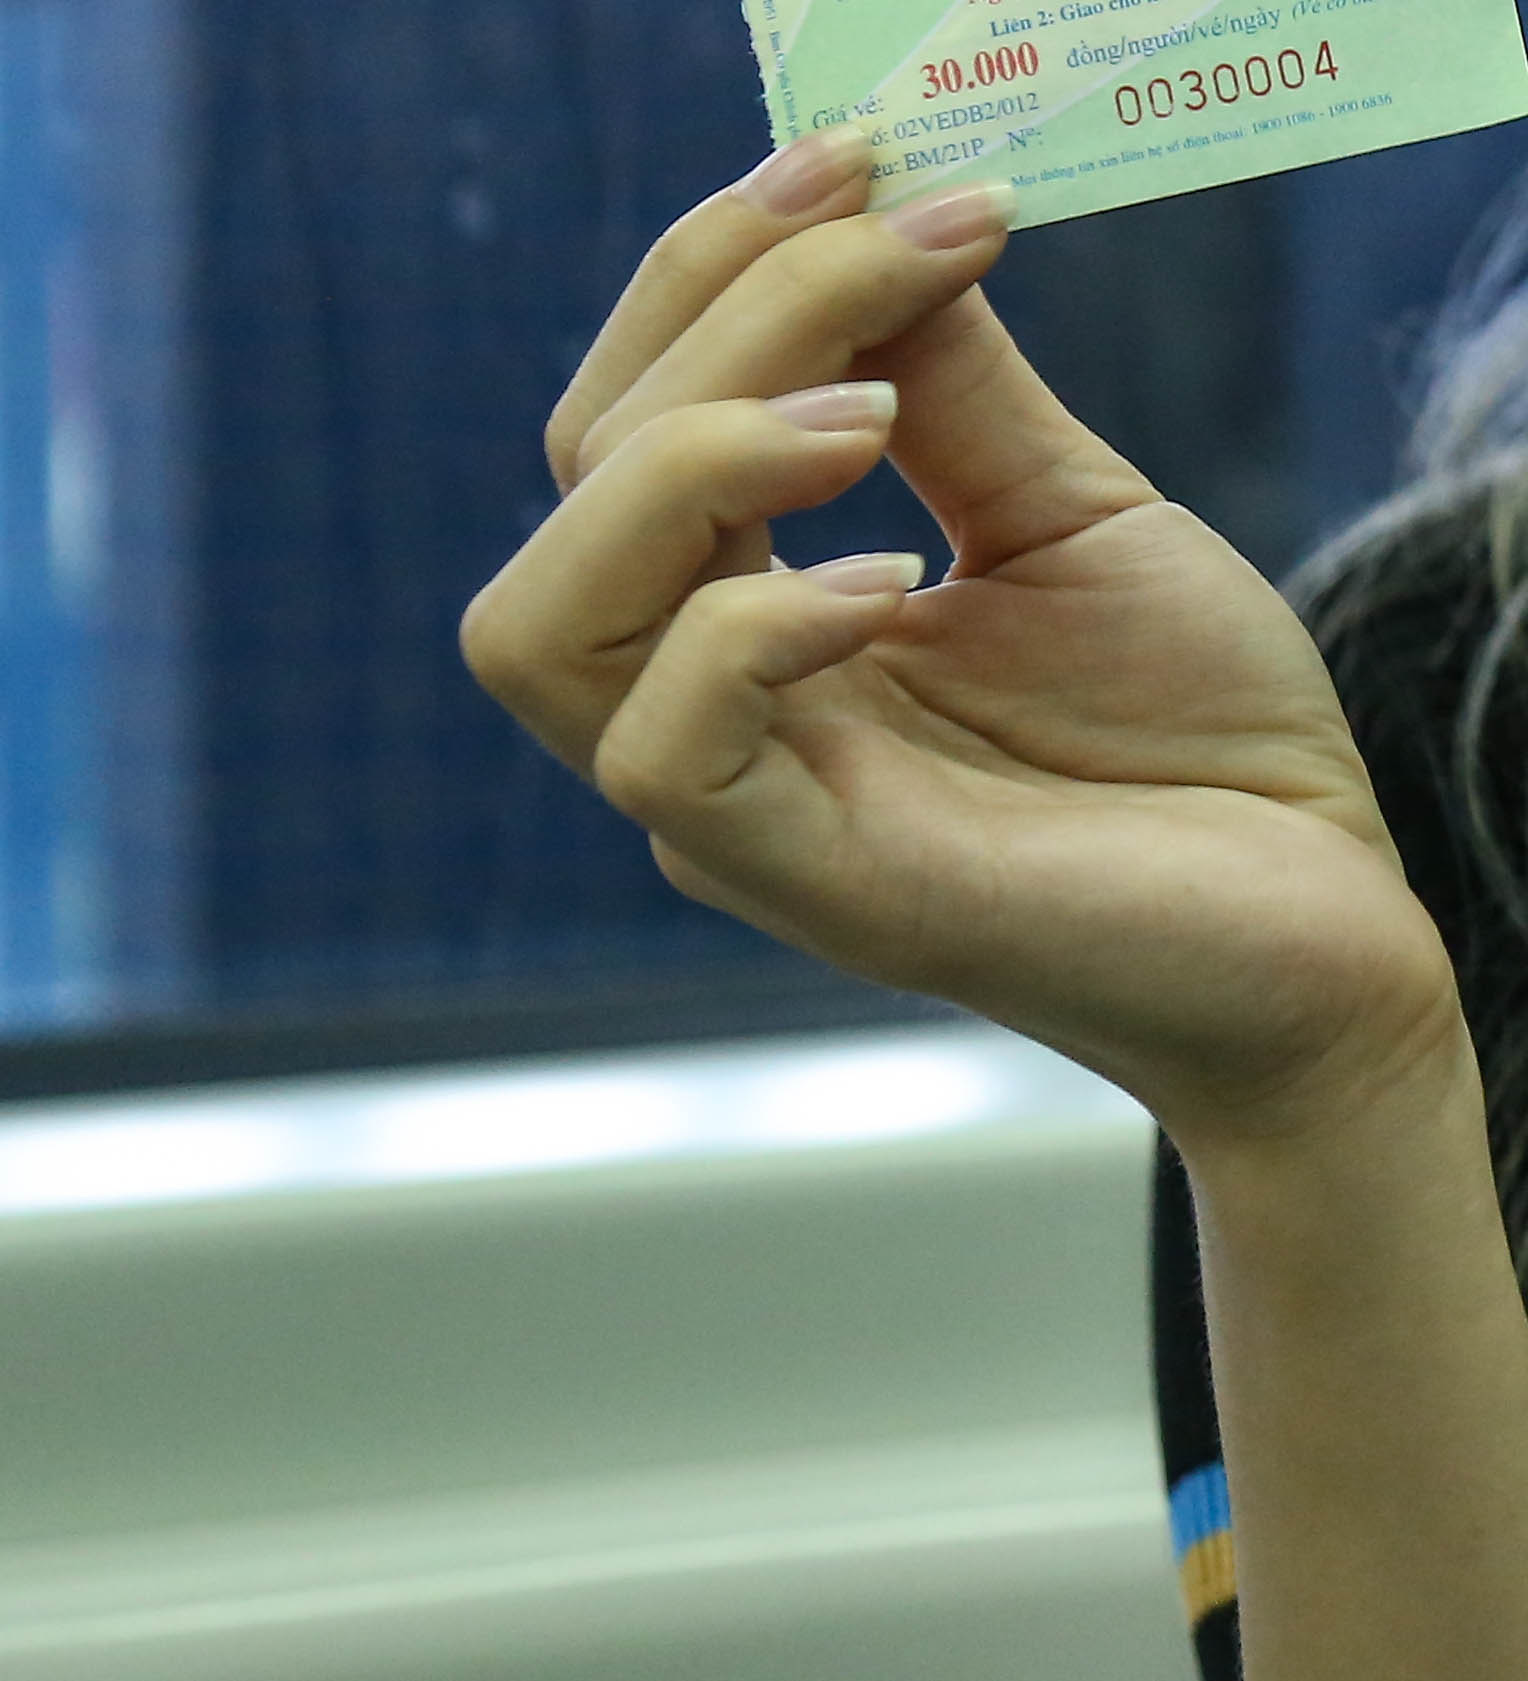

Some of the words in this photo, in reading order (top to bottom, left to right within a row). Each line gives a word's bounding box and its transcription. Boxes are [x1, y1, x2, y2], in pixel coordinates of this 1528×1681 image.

[989, 17, 1032, 38] Liên
[1036, 9, 1055, 28] 2:
[1059, 1, 1104, 21] Giao
[919, 40, 1039, 100] 30.000
[1114, 39, 1339, 126] 0030004
[1252, 117, 1282, 135] 1900
[1328, 99, 1359, 118] 1900
[903, 136, 985, 172] BM/21P
